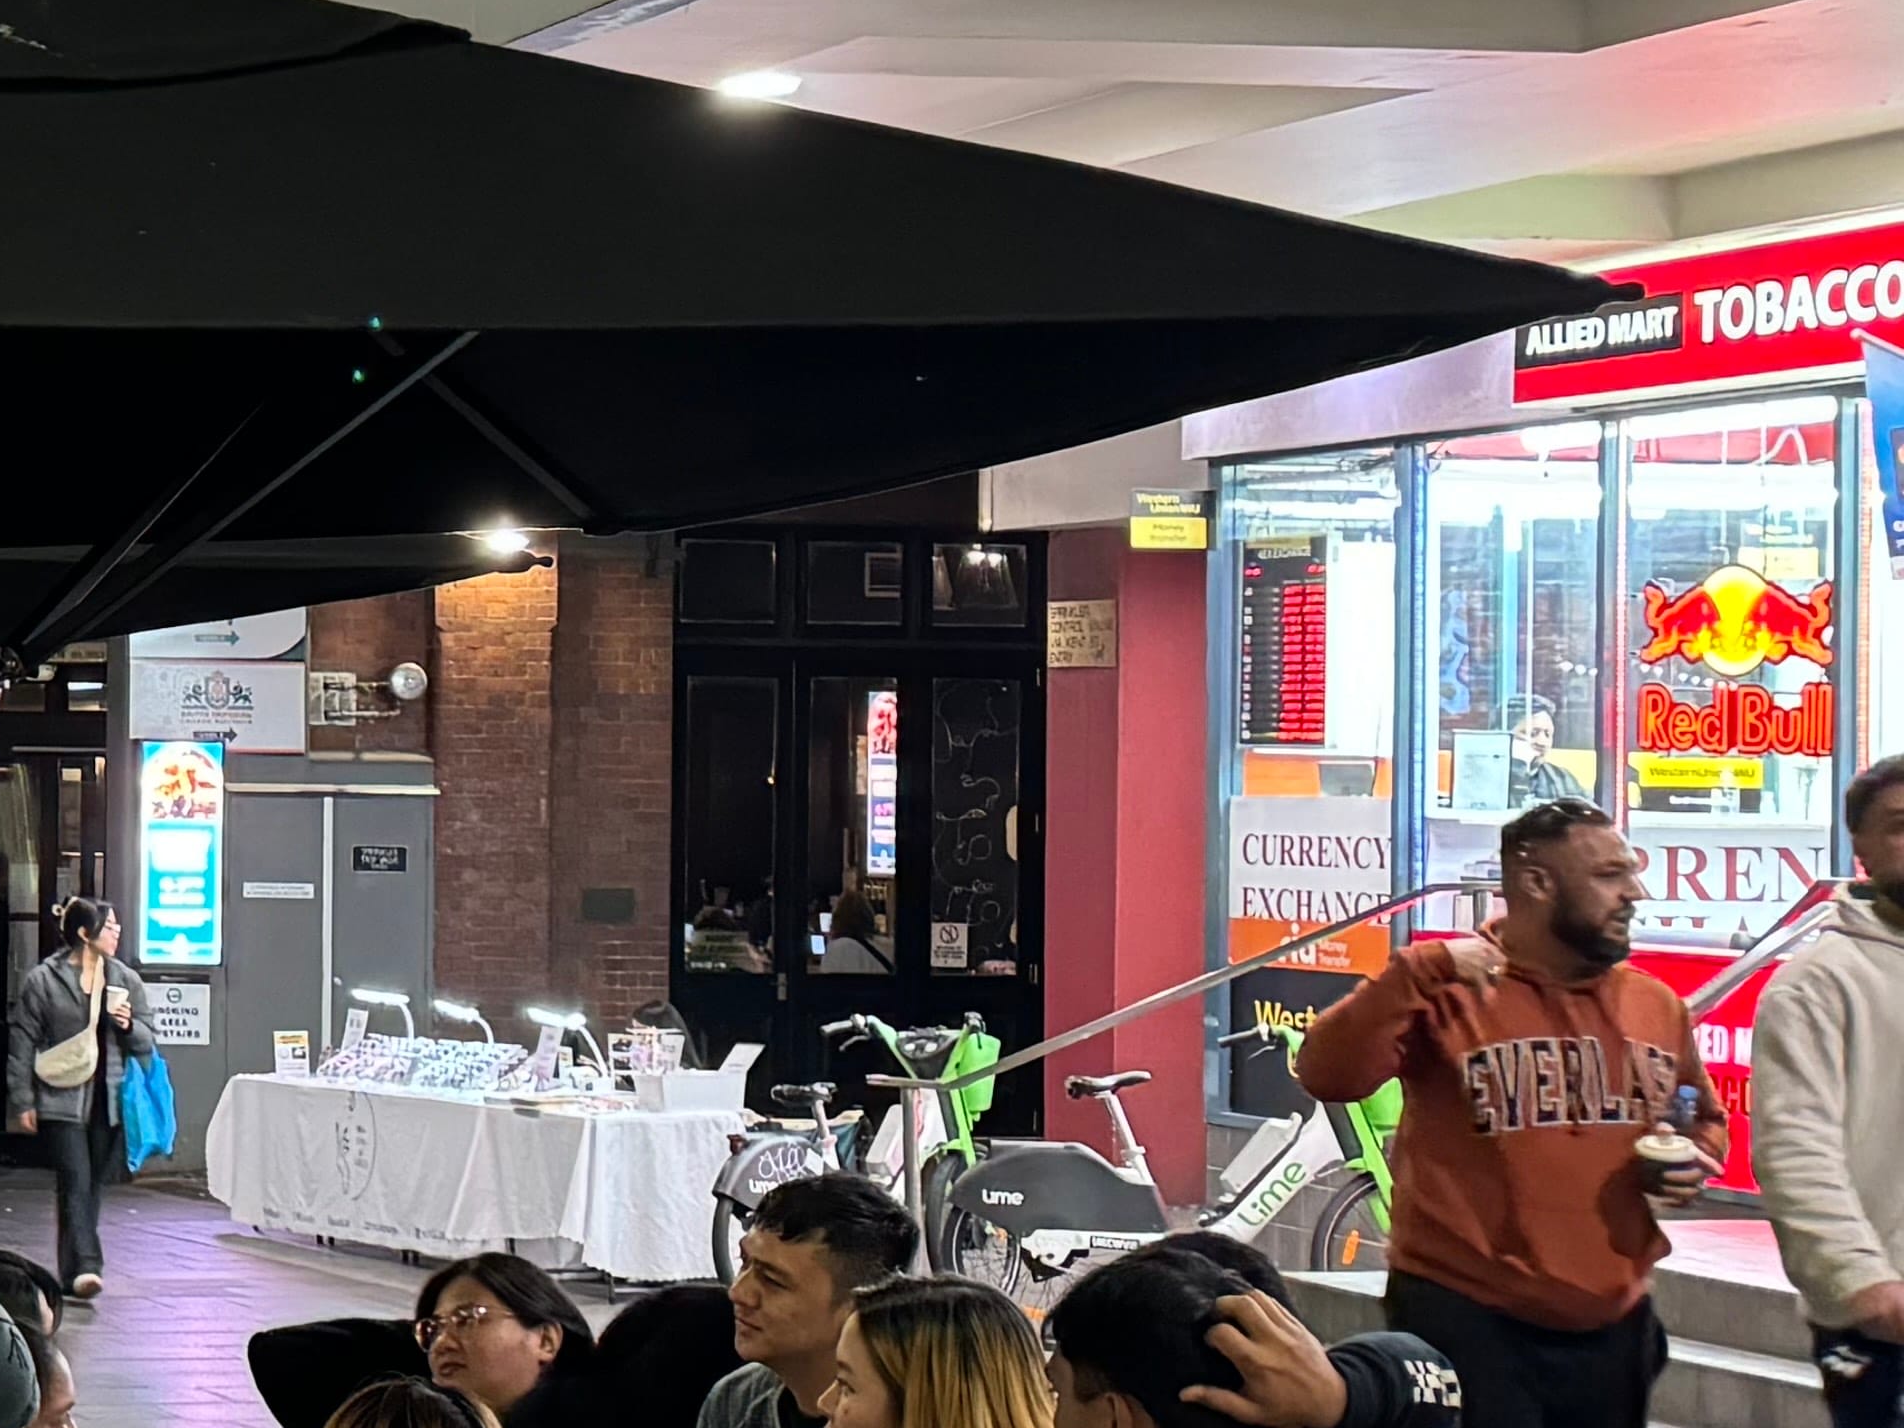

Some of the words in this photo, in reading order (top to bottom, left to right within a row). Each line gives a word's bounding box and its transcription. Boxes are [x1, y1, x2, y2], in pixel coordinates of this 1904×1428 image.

[1526, 316, 1606, 356] ALLIED
[1608, 304, 1680, 345] MART
[1694, 260, 1904, 345] TOBACCO
[1637, 682, 1729, 754] Red
[1736, 682, 1833, 757] Bull
[1243, 833, 1392, 870] CURRENCY
[1237, 1162, 1307, 1227] Lime
